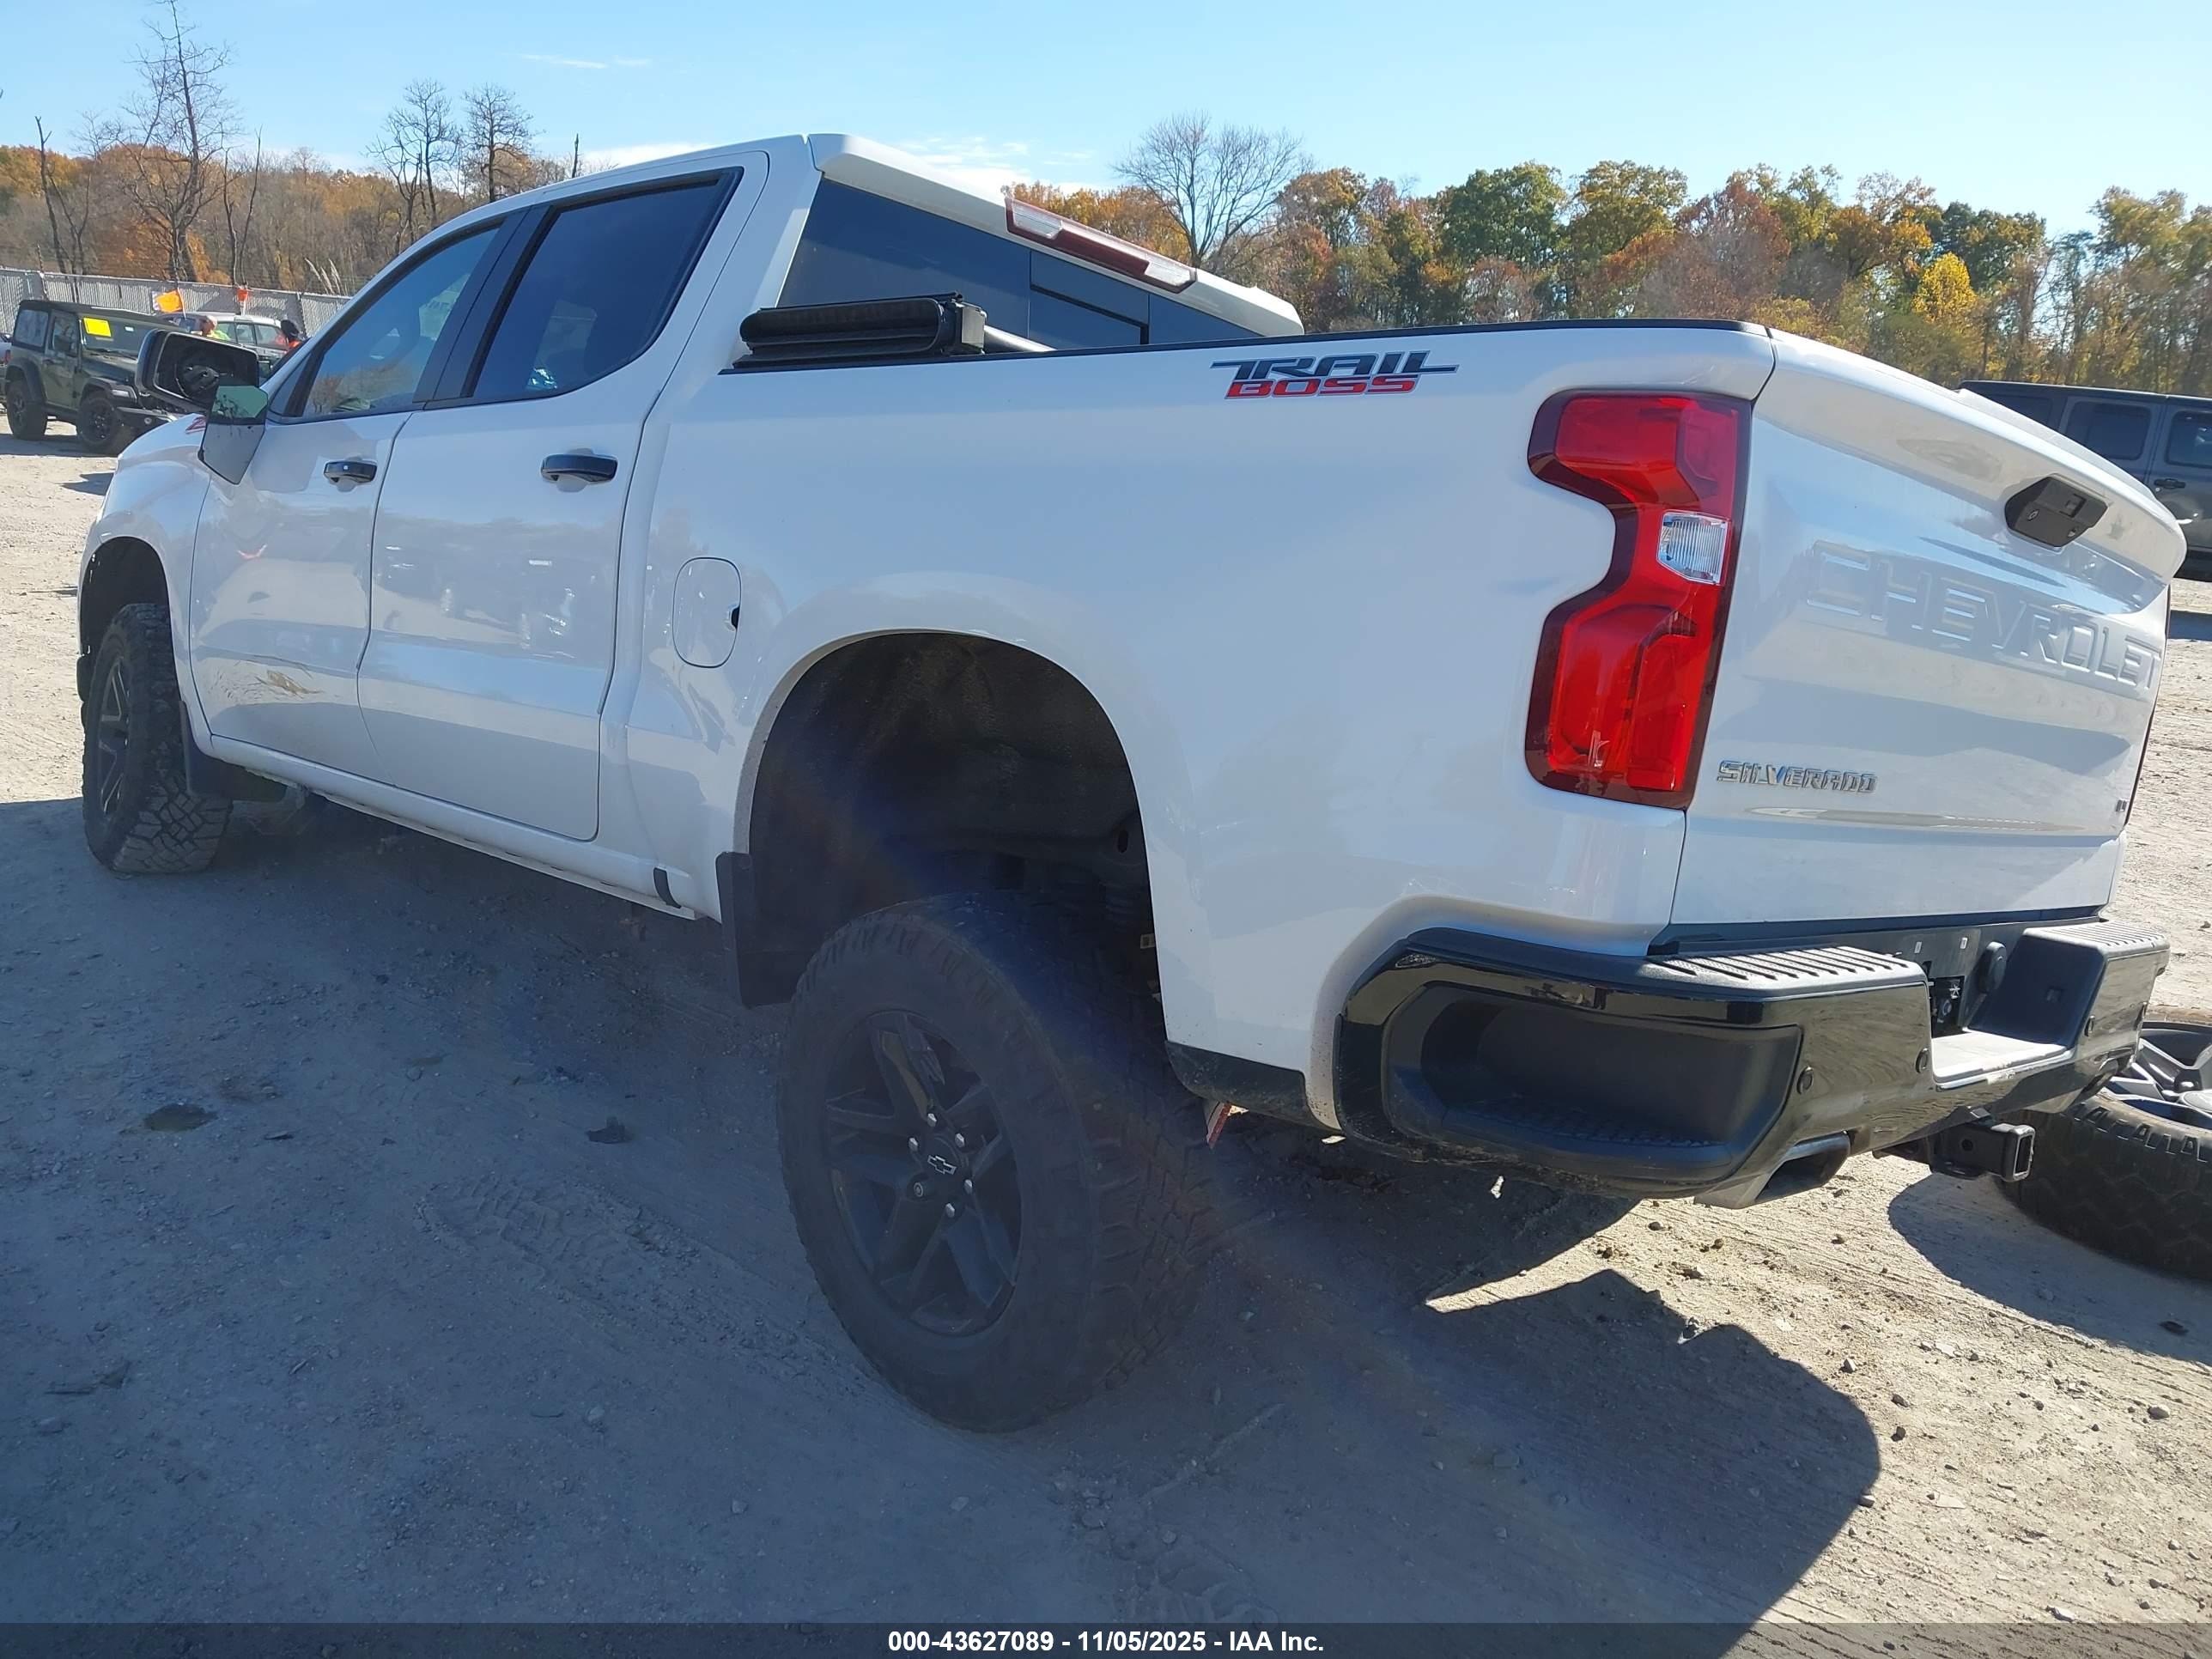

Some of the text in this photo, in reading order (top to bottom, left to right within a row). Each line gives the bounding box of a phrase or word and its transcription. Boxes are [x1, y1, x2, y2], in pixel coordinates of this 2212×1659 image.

[1210, 349, 1460, 380] TRAIL
[1224, 374, 1421, 399] BOSS
[1806, 539, 2161, 690] CHEVROLET
[1717, 759, 1878, 793] SILVERADO
